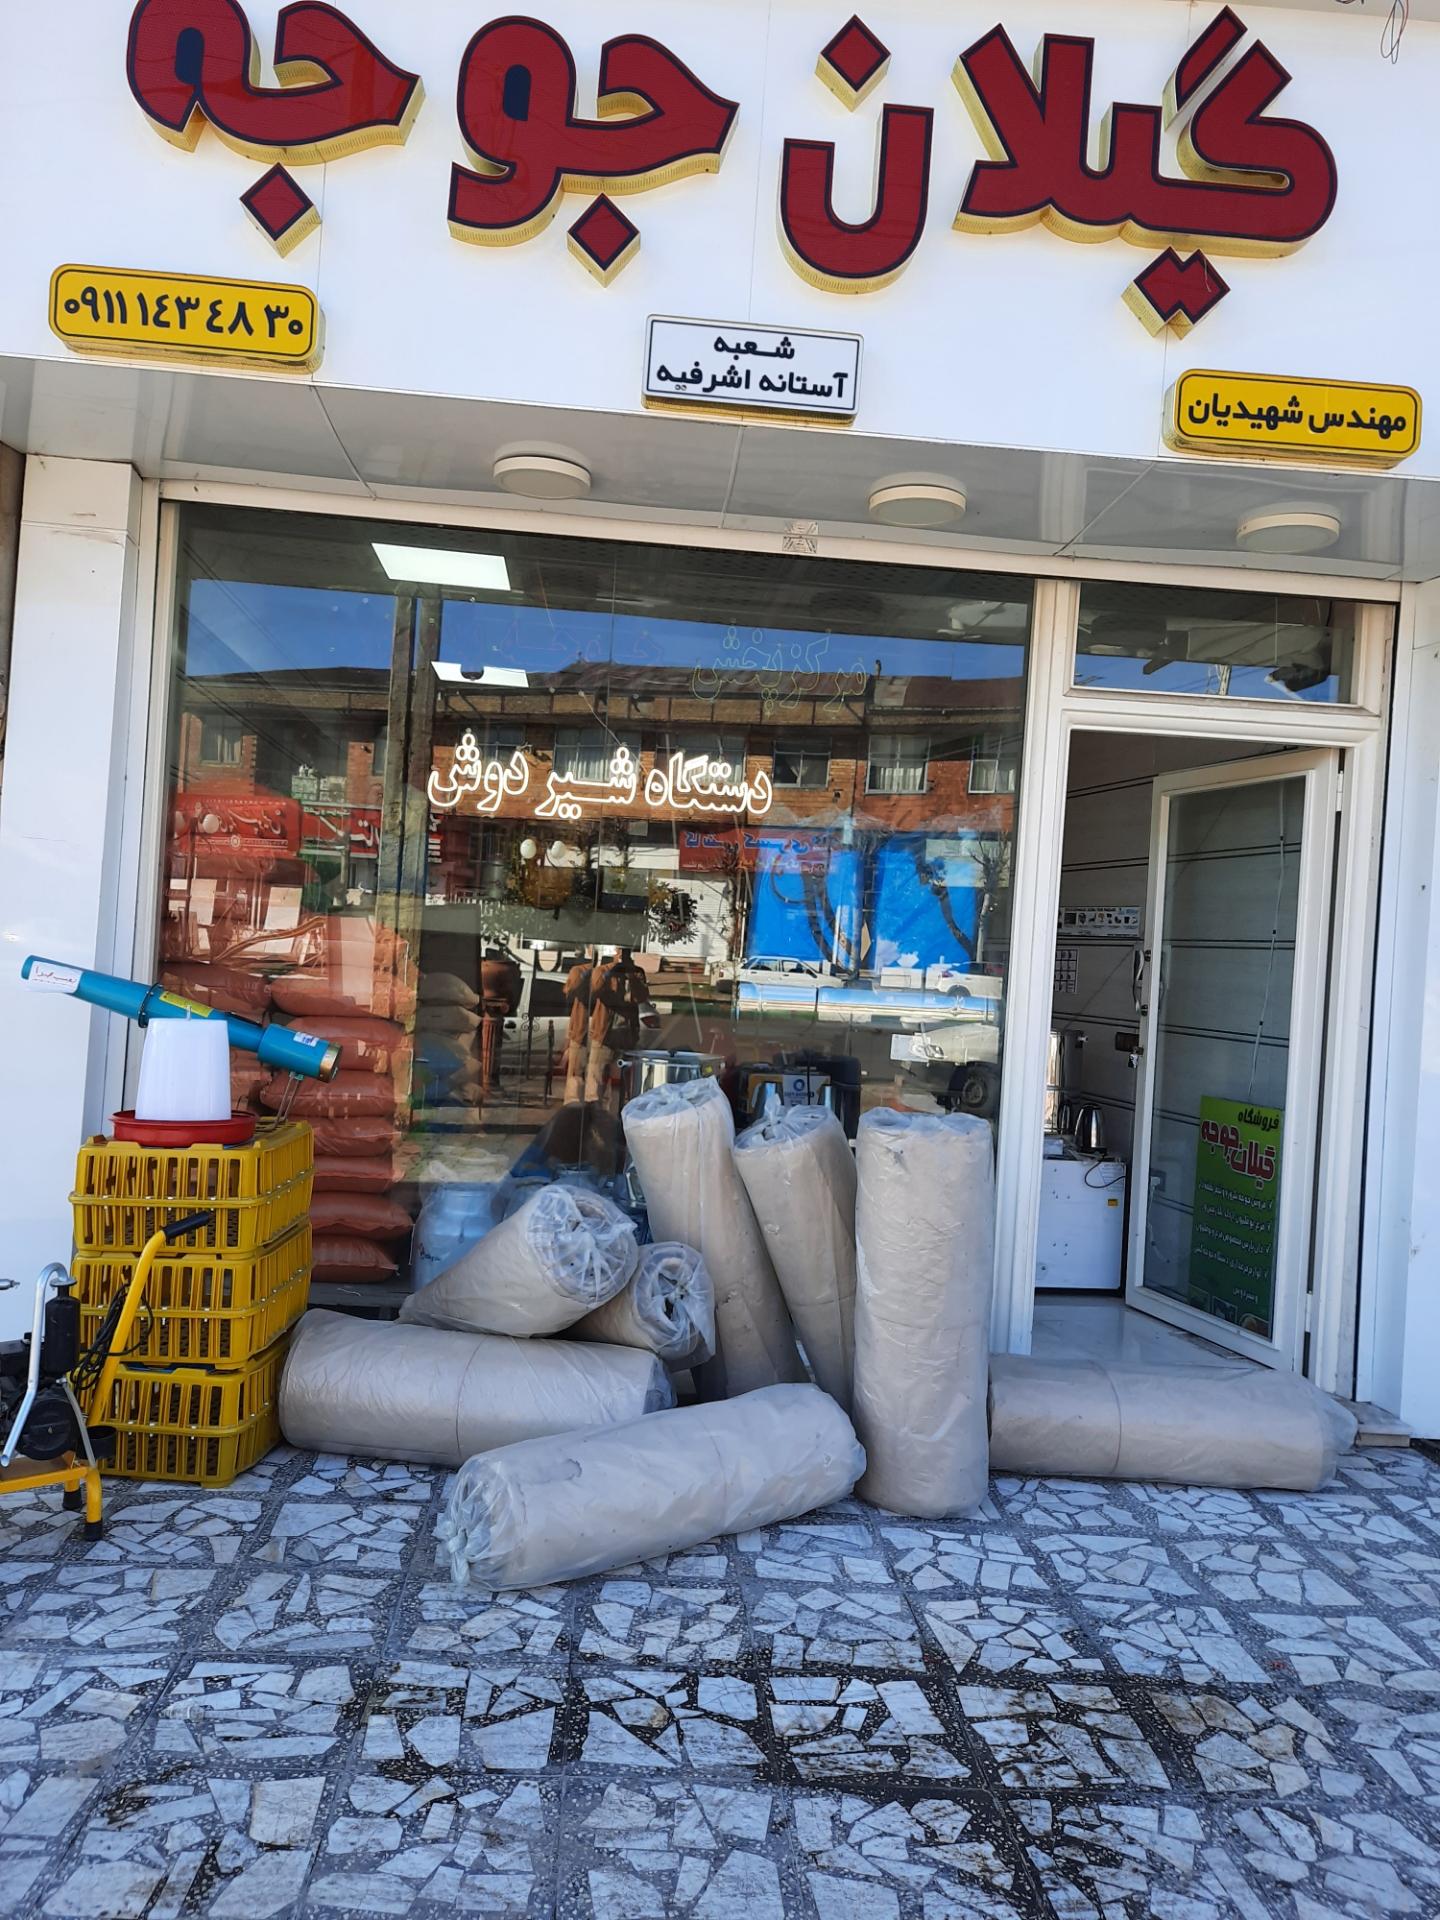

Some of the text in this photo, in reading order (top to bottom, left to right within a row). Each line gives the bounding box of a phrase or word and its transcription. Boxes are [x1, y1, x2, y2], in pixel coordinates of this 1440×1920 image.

[126, 0, 1337, 325] گیلان جوجه
[714, 336, 795, 361] شعبه
[656, 361, 849, 398] آستانه اشرفیه
[1187, 393, 1407, 439] مهندس شهیدیان
[644, 751, 773, 814] دستگاه
[1237, 1108, 1280, 1131] فروشگاه
